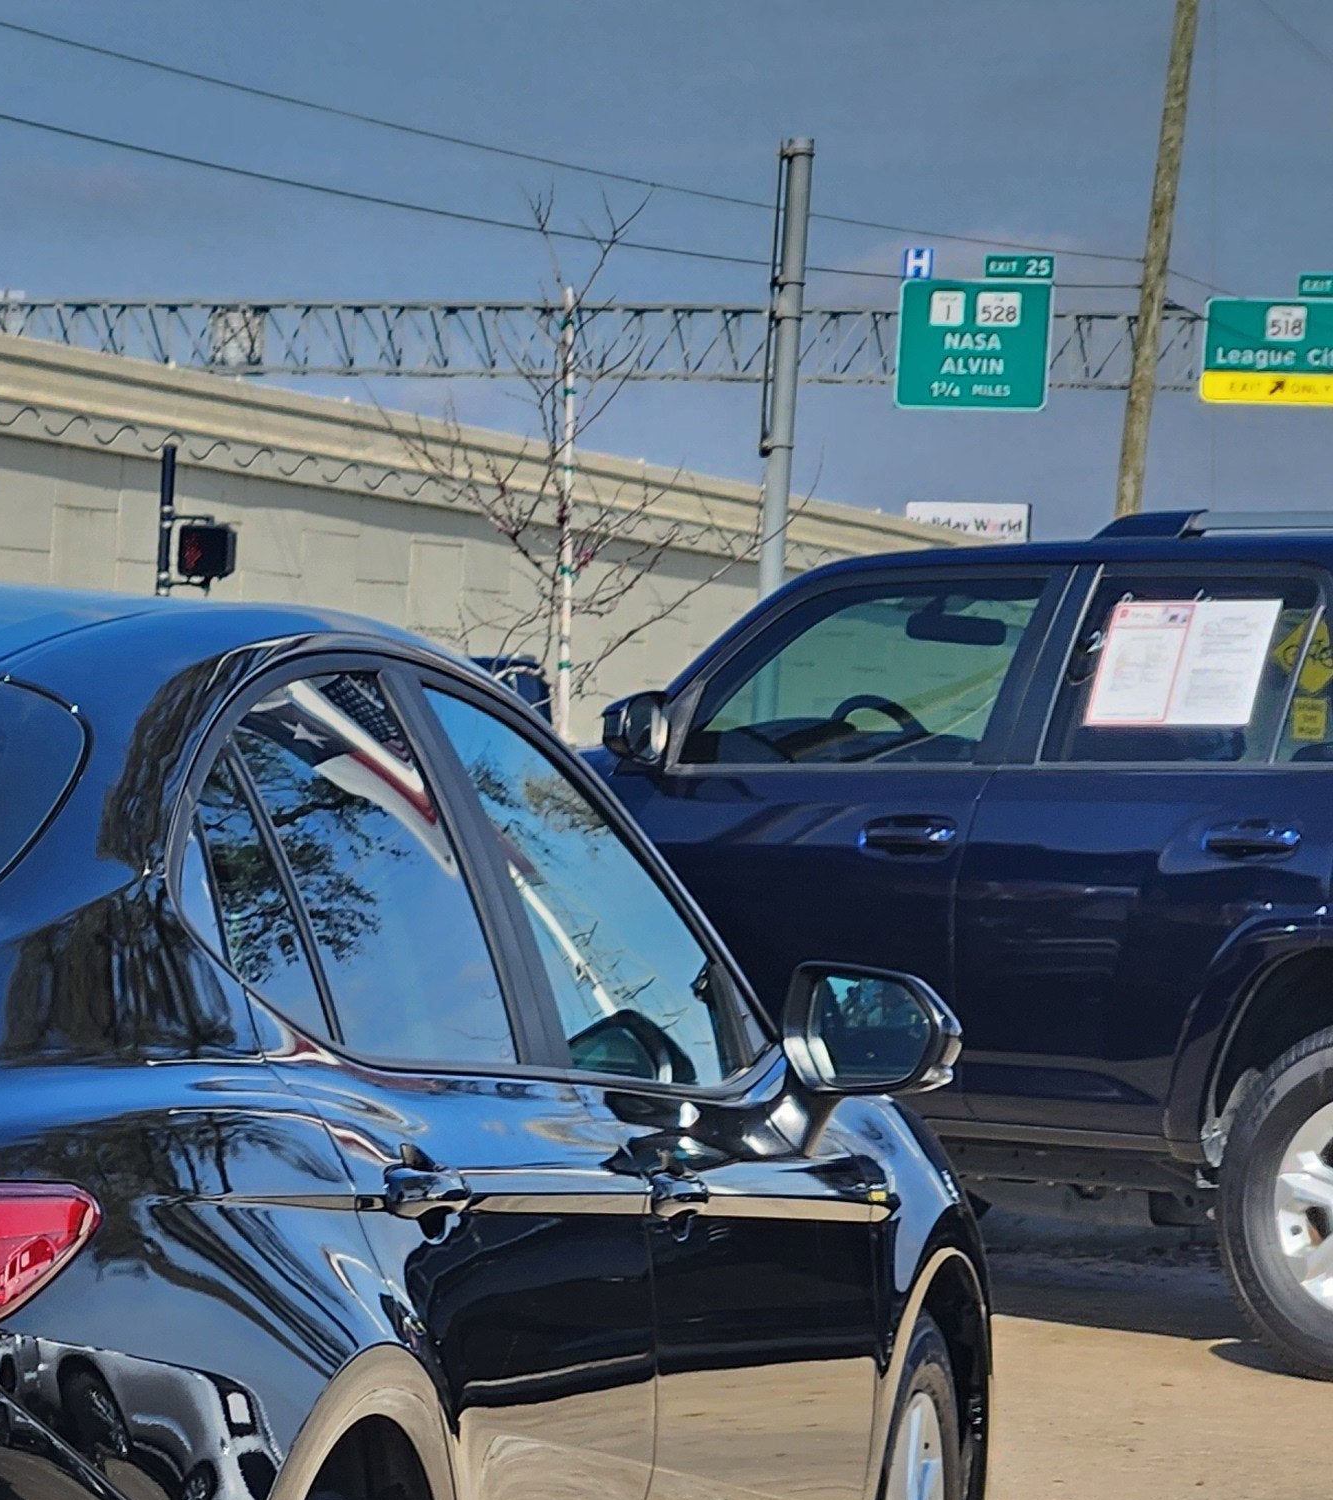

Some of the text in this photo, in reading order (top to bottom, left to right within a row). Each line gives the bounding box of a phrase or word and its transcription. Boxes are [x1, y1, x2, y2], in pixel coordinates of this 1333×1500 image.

[989, 258, 1051, 276] EXIT 25
[981, 304, 1017, 323] 528
[1271, 319, 1303, 337] 518
[944, 332, 1001, 351] NASA
[940, 356, 1004, 375] ALVIN
[1216, 346, 1296, 369] League
[971, 384, 1011, 397] MILES
[974, 517, 1023, 532] World
